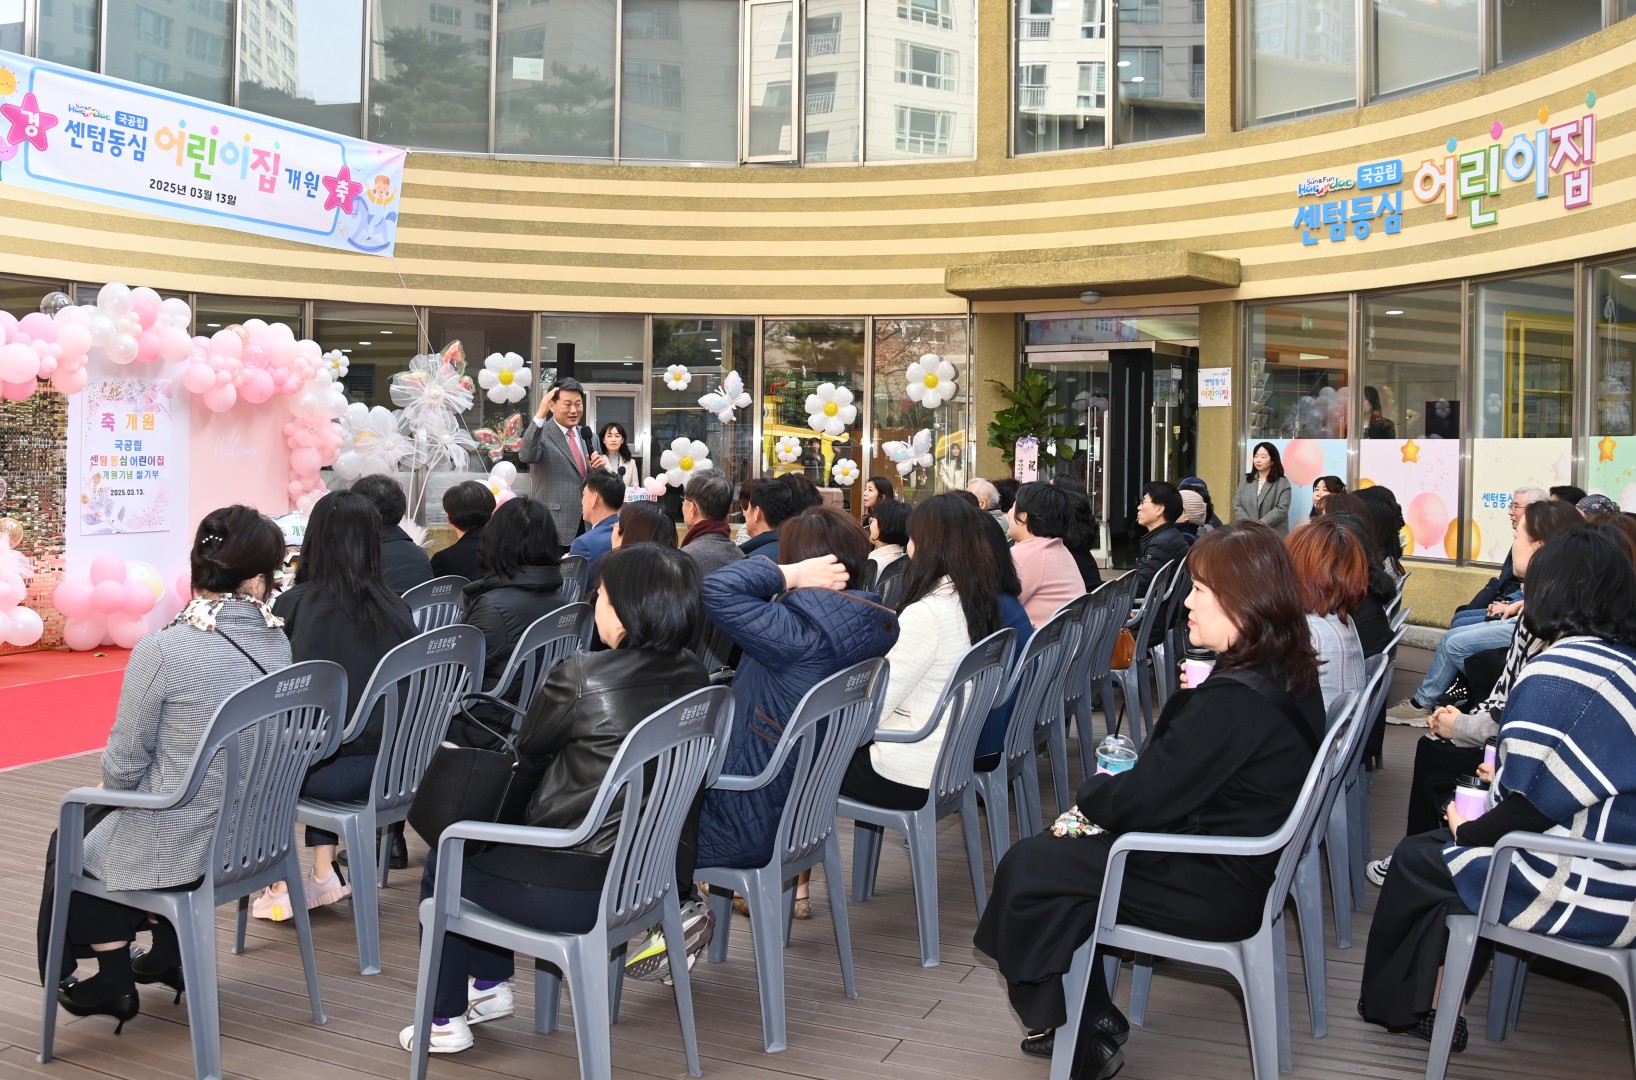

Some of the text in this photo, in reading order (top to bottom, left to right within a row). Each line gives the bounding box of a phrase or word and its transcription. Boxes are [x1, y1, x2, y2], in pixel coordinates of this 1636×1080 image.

[21, 110, 40, 137] 경
[118, 113, 145, 129] 국공립
[64, 119, 320, 198] 센텀동심 어린이집 개원
[1293, 113, 1596, 246] 센텀동심 어린이집
[1306, 176, 1335, 186] Sun&Fun
[1361, 163, 1397, 184] 국공립
[149, 178, 237, 206] 2025년 03월 13일
[335, 180, 349, 203] 축
[1297, 178, 1353, 195] Haeundae
[1201, 388, 1229, 400] 어린이집
[101, 412, 155, 432] 축 개원
[114, 439, 142, 451] 국공립
[130, 455, 165, 467] 어린이집
[102, 470, 159, 480] 개원기념 쌀기부
[110, 488, 145, 496] 2025.03.13.
